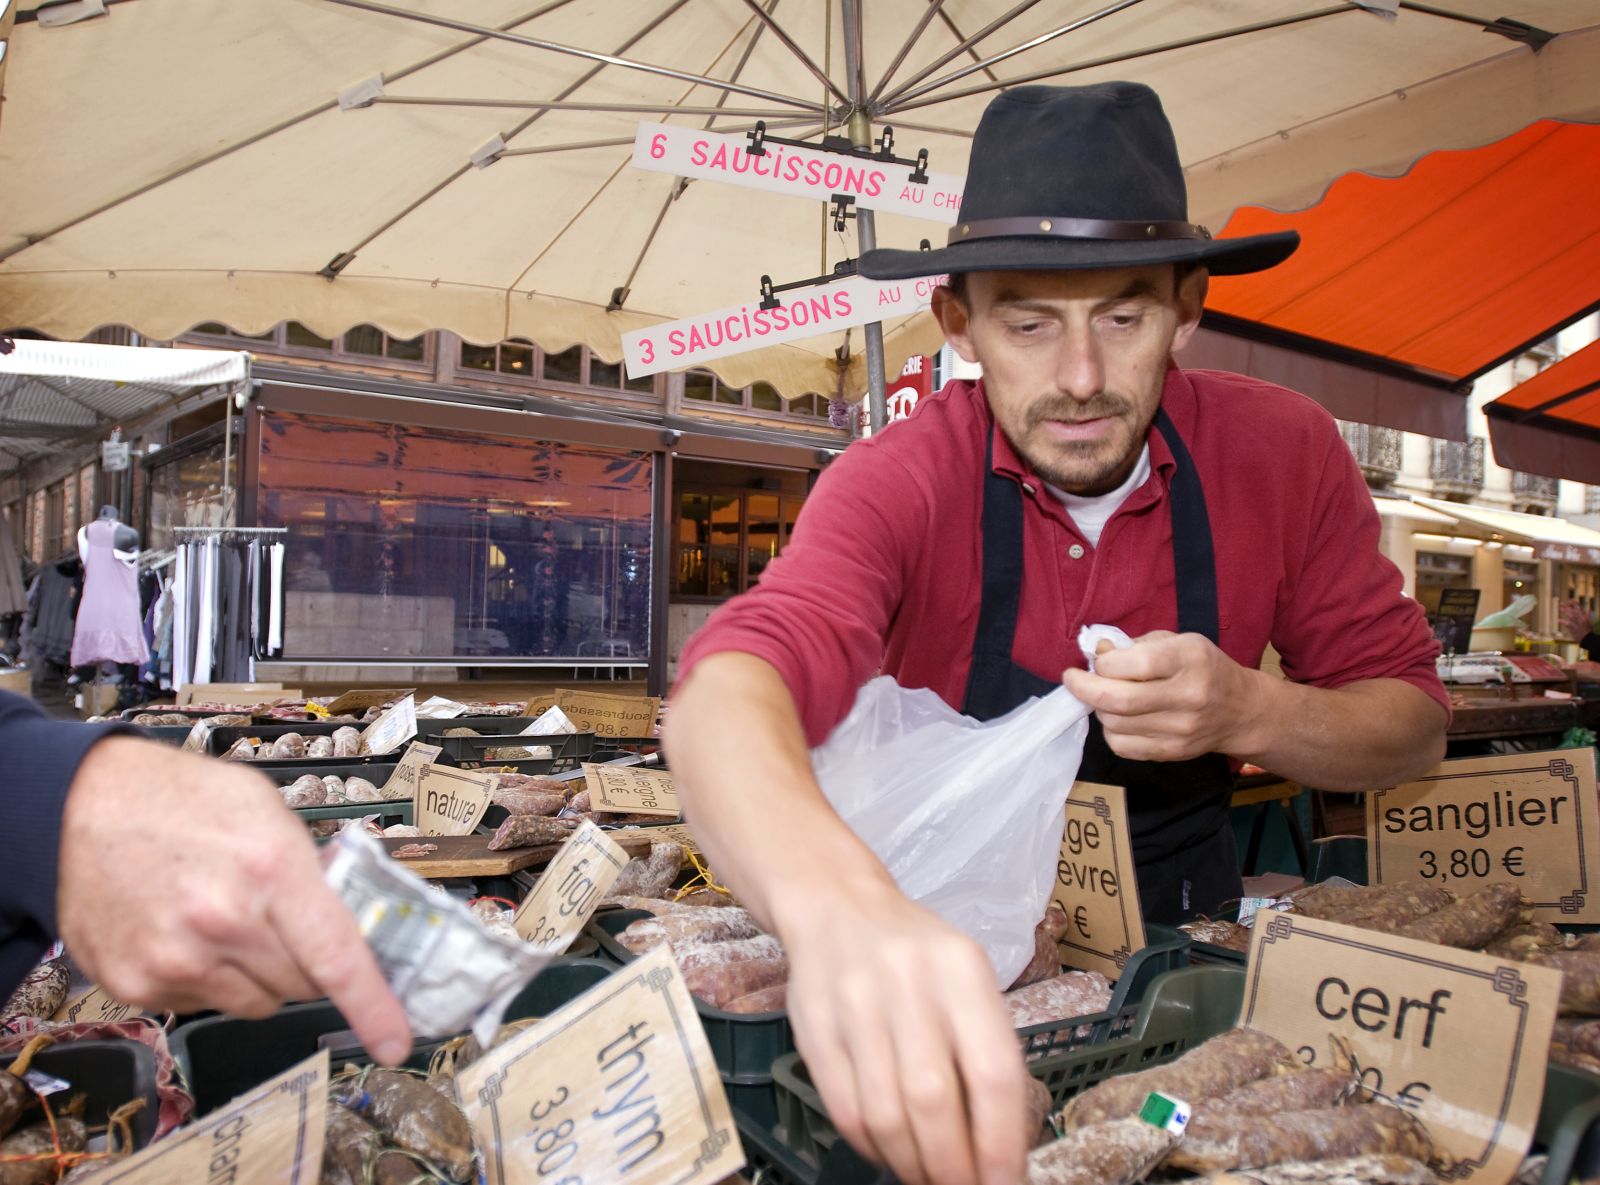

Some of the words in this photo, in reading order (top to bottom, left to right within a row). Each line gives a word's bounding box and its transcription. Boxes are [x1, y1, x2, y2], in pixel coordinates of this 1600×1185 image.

[650, 133, 667, 159] 6
[899, 185, 924, 204] AU
[638, 338, 655, 365] 3
[878, 286, 901, 306] AU
[426, 790, 476, 824] nature
[1062, 818, 1100, 855] ge
[1384, 790, 1567, 838] sanglier
[1418, 848, 1491, 883] 3,80
[1501, 846, 1526, 877] €
[1073, 905, 1092, 939] €
[1315, 976, 1452, 1048] cerf
[592, 1020, 667, 1174] thym
[525, 1086, 580, 1177] 3,80
